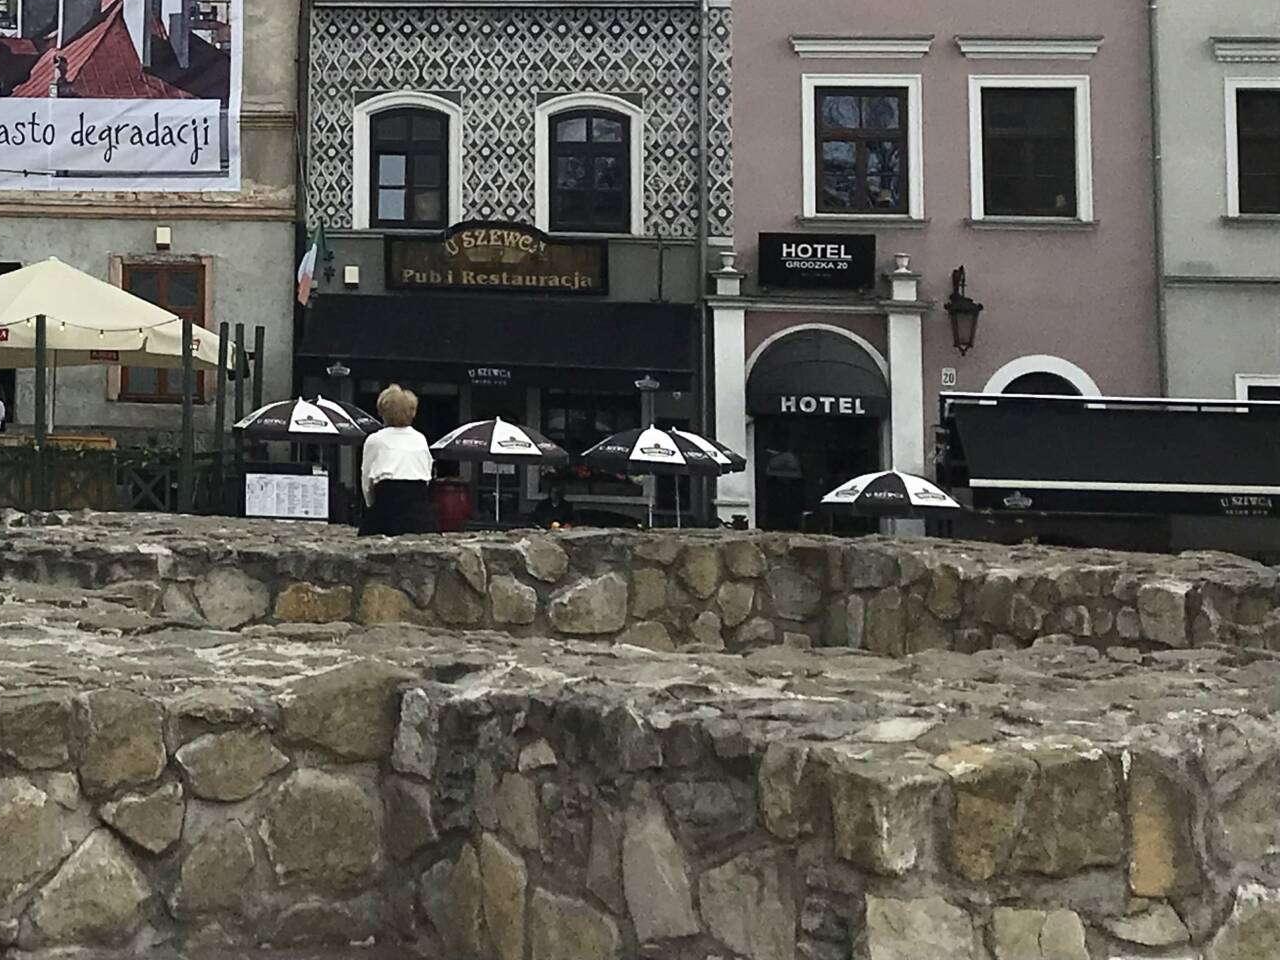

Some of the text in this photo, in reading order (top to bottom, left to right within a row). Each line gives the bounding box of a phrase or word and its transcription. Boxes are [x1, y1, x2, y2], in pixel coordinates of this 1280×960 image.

[70, 111, 210, 165] degradacji
[444, 239, 460, 256] U
[781, 243, 853, 259] HOTEL
[785, 259, 849, 270] GRODZKA 20
[401, 269, 442, 285] Pub
[461, 270, 593, 289] Restauracja
[943, 372, 955, 384] 20
[780, 396, 866, 415] HOTEL
